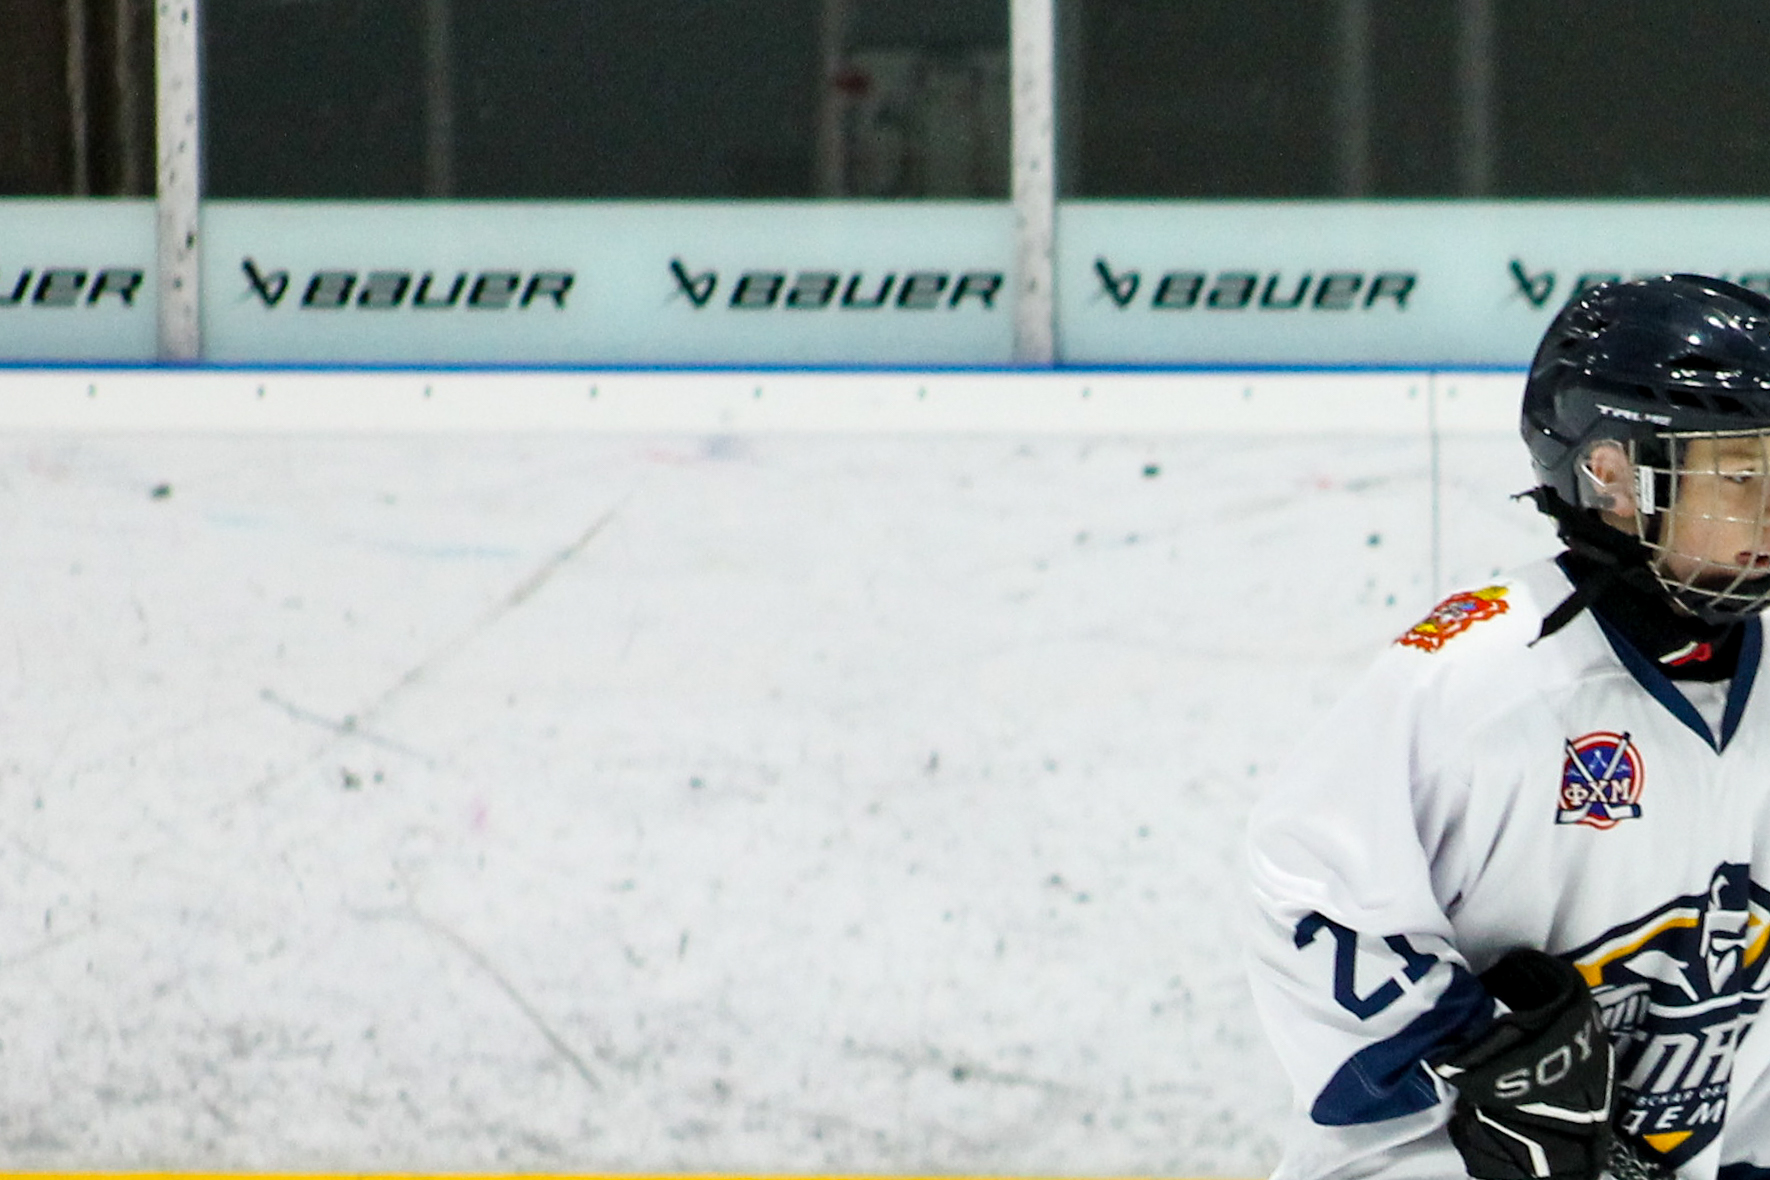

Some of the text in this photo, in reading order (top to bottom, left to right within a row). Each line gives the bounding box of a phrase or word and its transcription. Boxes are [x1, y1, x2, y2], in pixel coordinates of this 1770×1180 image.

[300, 270, 576, 310] BAUER
[728, 271, 1006, 310] BAUER
[1150, 271, 1418, 311] BAUER
[1564, 777, 1632, 807] ФХМ
